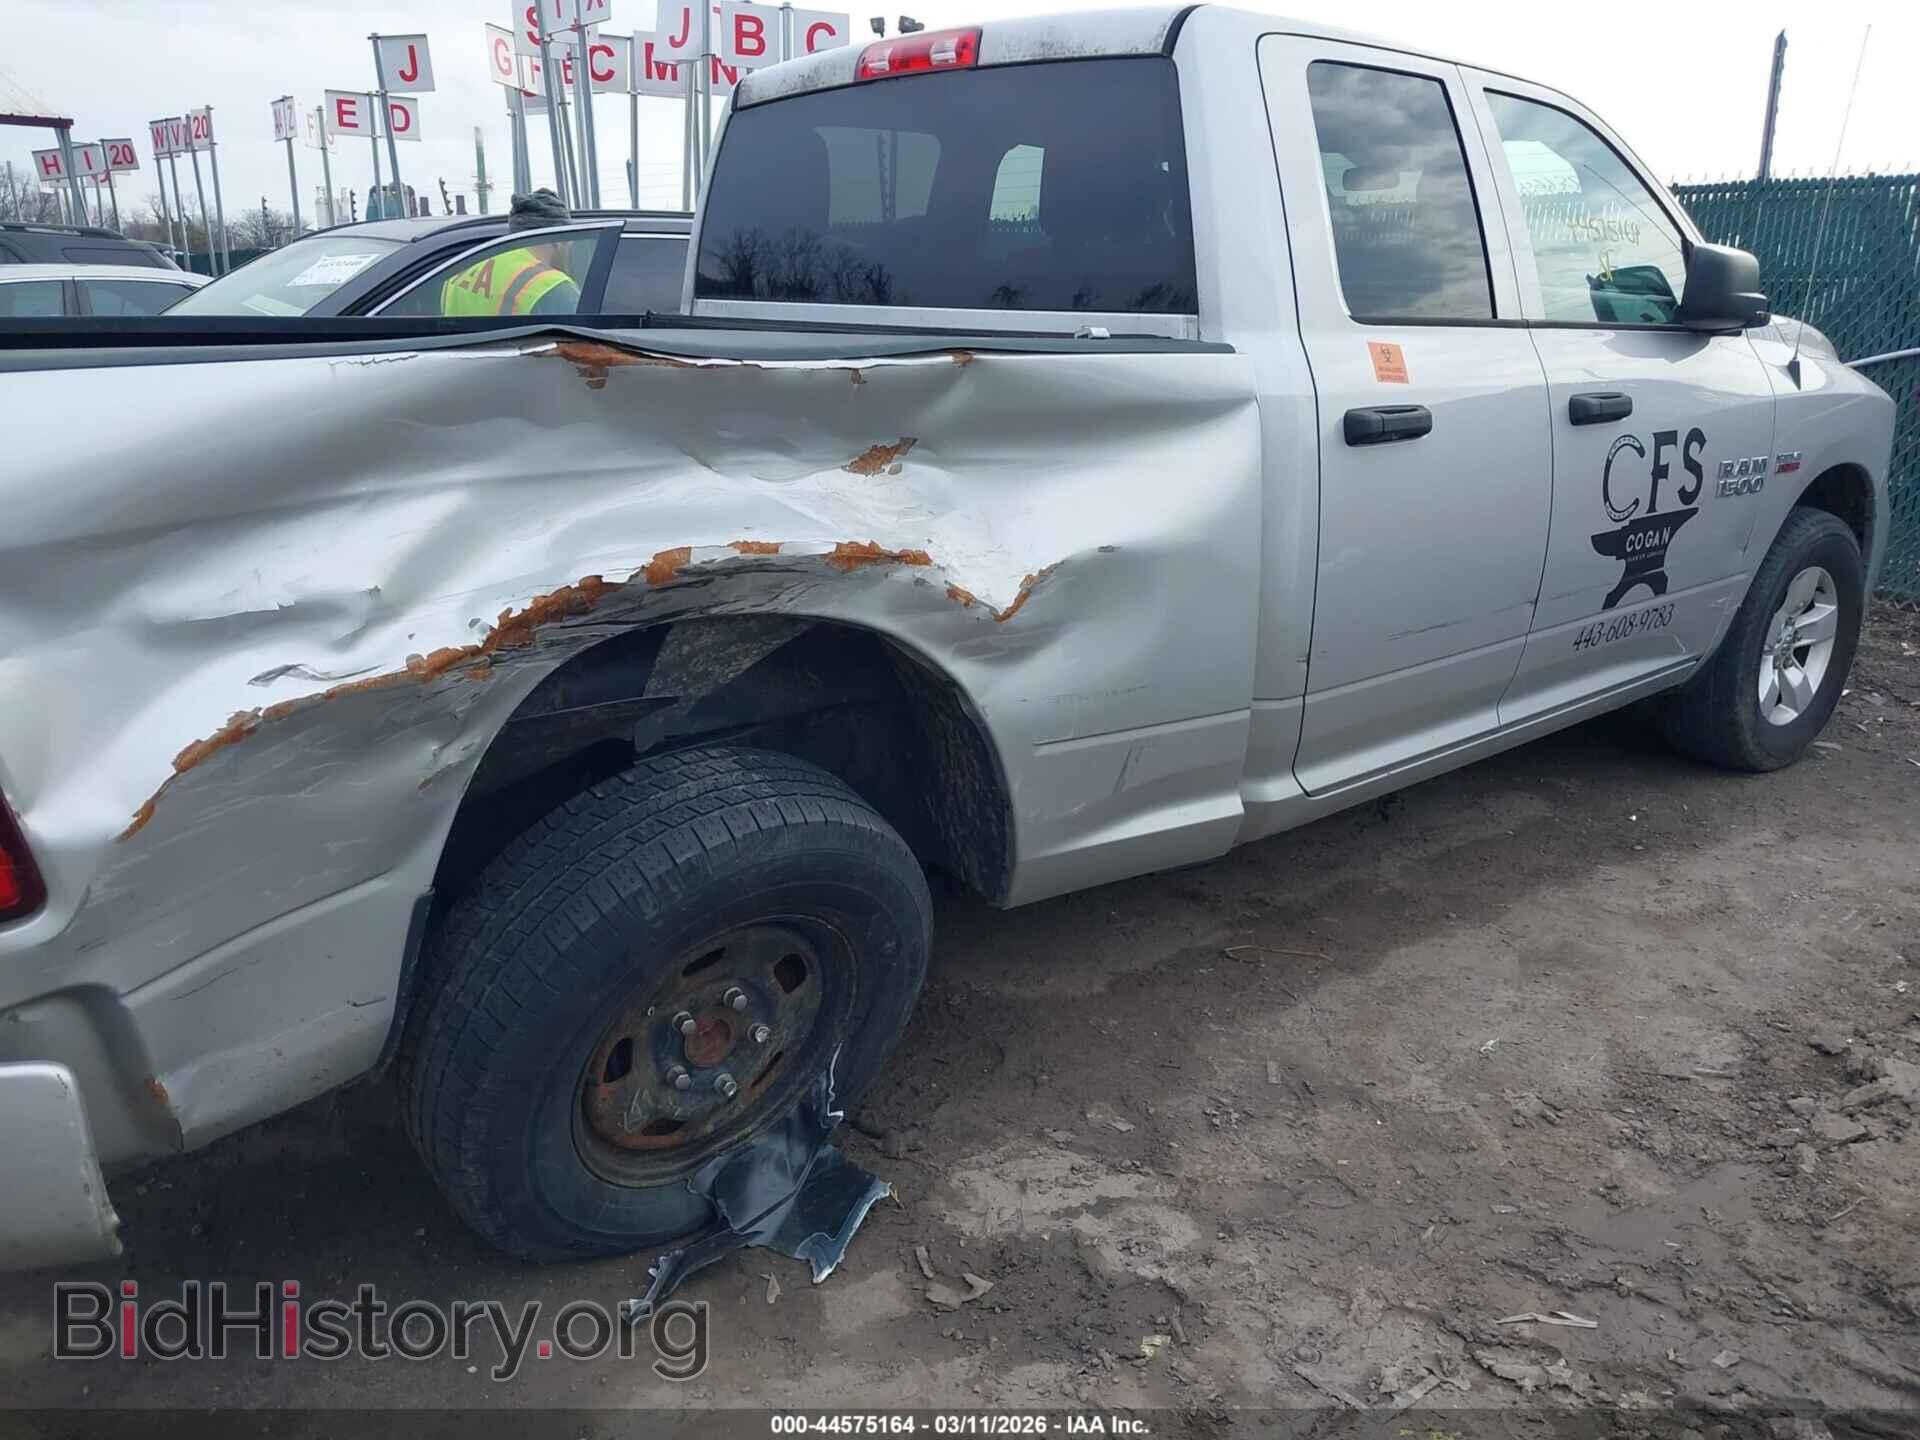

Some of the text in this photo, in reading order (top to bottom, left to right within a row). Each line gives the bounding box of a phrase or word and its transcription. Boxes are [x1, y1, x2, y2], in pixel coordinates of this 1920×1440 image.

[668, 7, 690, 48] J
[734, 14, 766, 56] B
[398, 44, 418, 83] J
[494, 38, 513, 76] G
[589, 44, 616, 82] C
[193, 115, 209, 139] 20
[336, 98, 359, 128] E
[390, 104, 411, 132] D
[170, 123, 180, 146] V
[41, 154, 61, 176] H
[109, 144, 134, 166] 20
[1602, 427, 1707, 523] CFS
[1718, 456, 1768, 479] RAM
[1715, 476, 1764, 497] 1500
[1626, 526, 1671, 552] COGAN
[1573, 604, 1675, 651] 443-608-9783
